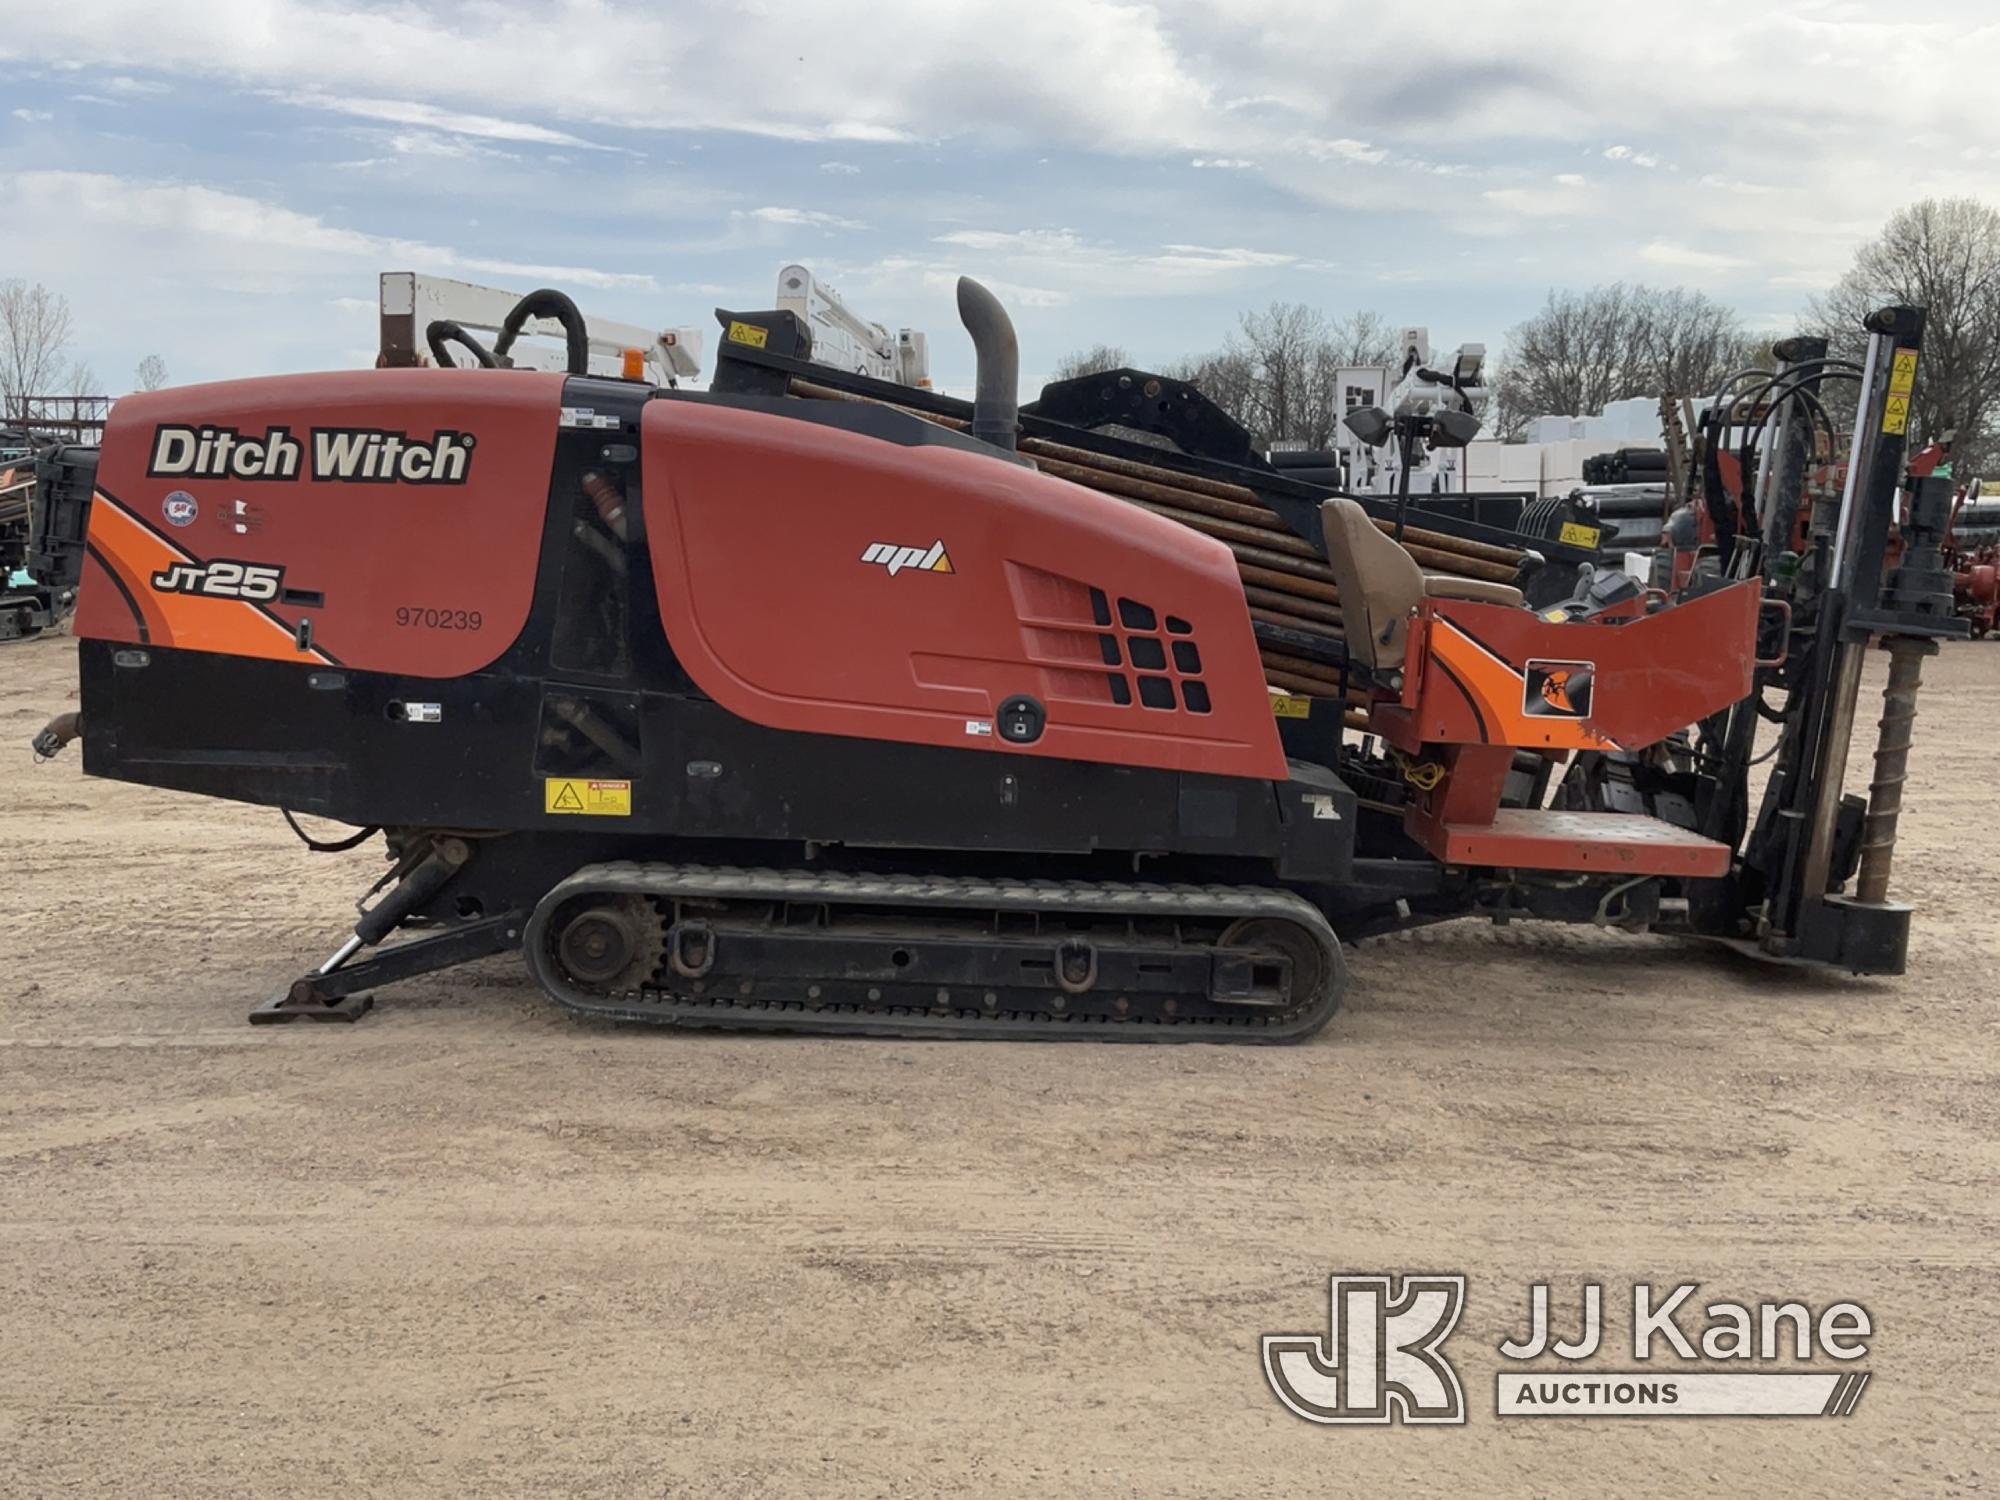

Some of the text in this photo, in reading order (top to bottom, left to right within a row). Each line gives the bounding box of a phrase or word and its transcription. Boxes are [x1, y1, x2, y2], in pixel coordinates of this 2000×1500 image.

[153, 429, 300, 475] Ditch
[155, 563, 280, 599] JT25
[396, 606, 482, 630] 970239
